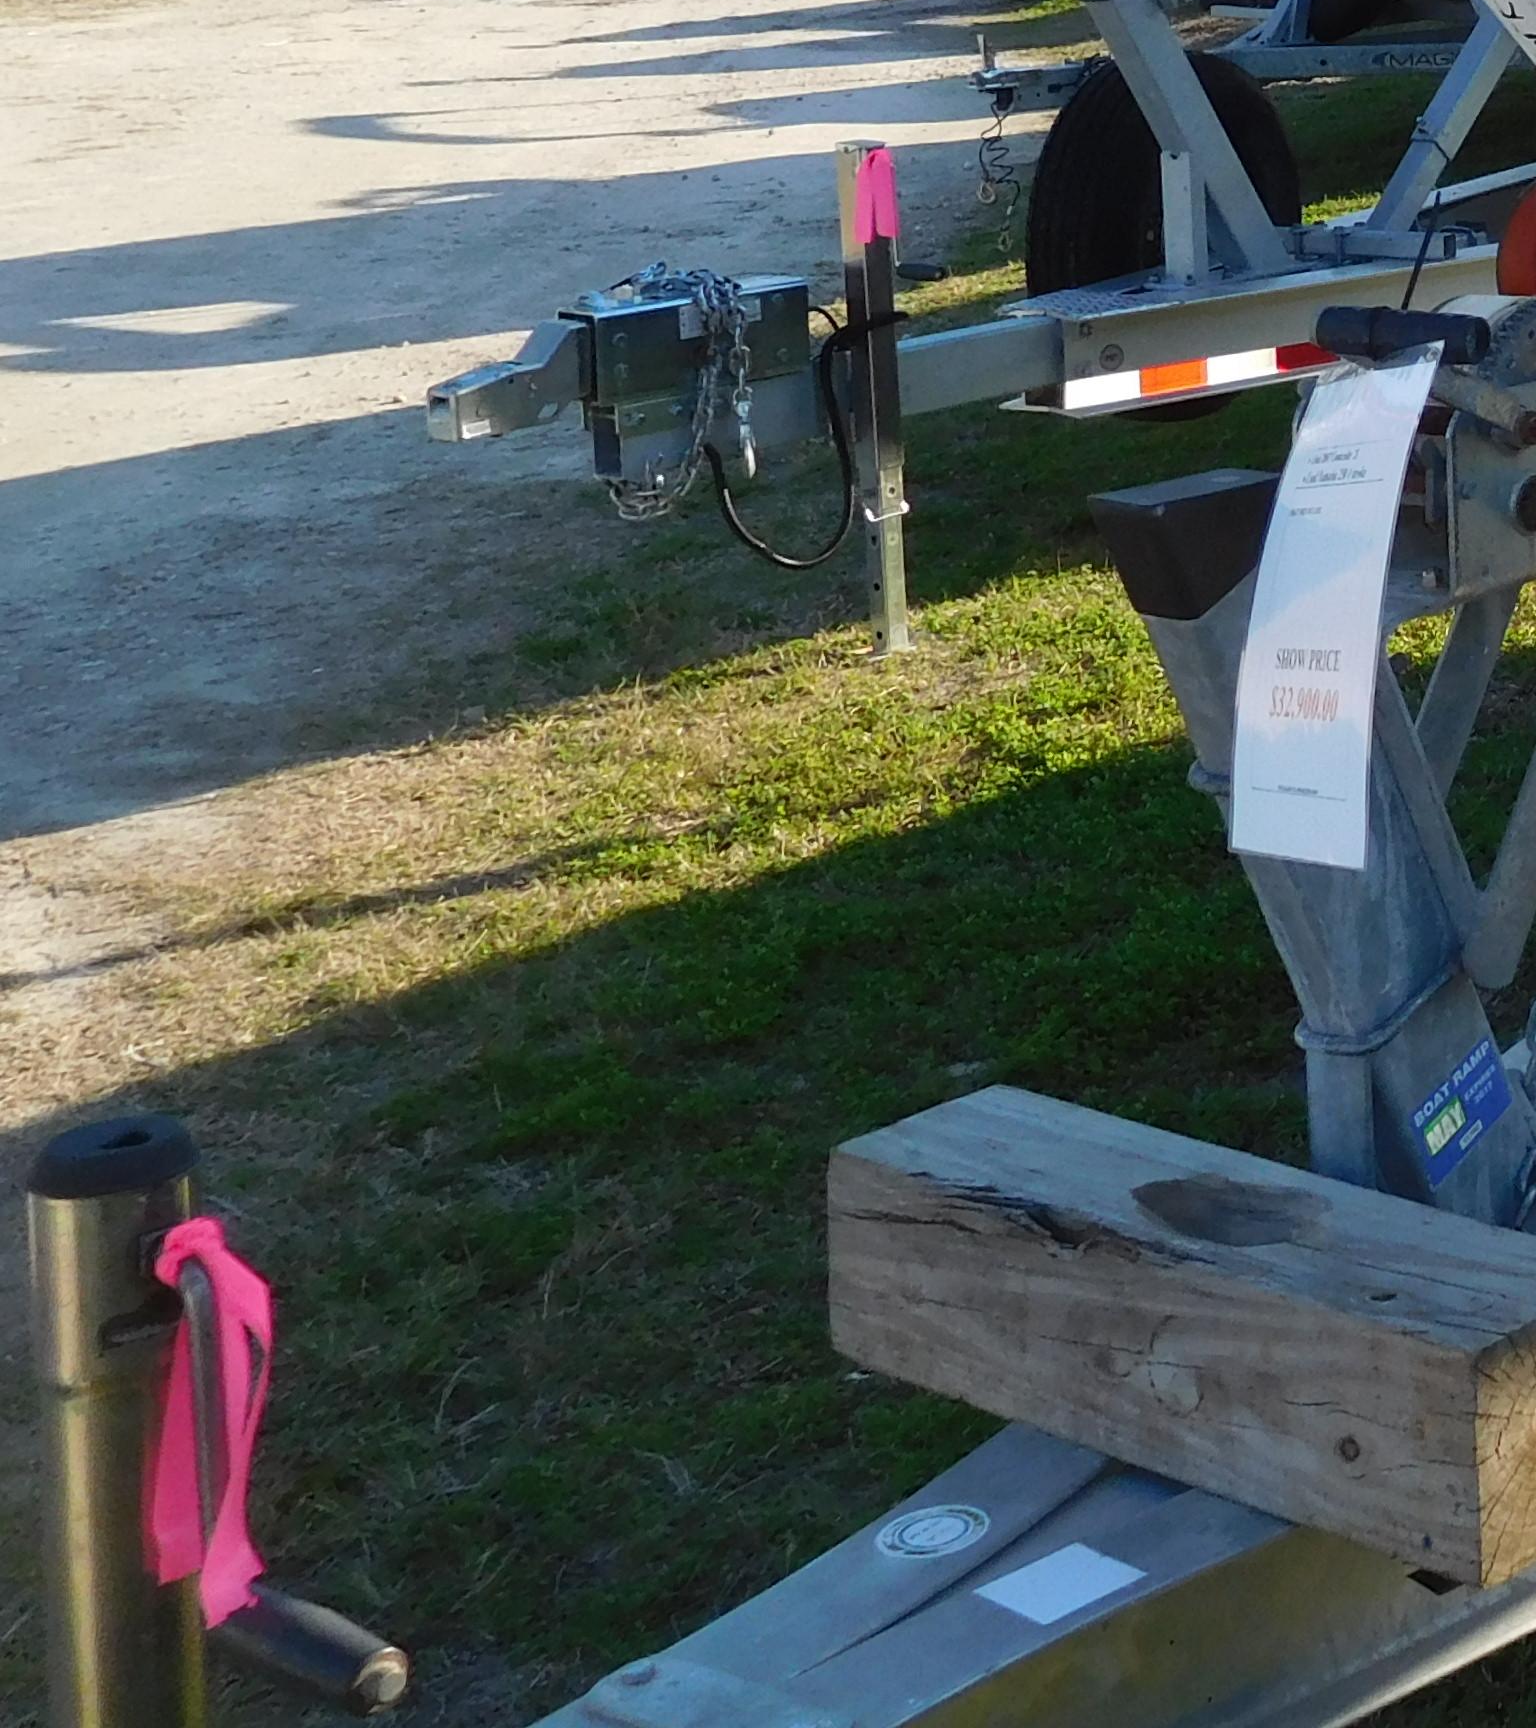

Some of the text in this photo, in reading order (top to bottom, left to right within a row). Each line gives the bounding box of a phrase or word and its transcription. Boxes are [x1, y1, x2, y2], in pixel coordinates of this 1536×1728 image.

[1275, 647, 1342, 672] SHOW PRICE
[1413, 1082, 1451, 1128] BOAT
[1452, 1040, 1491, 1087] RAMP
[1425, 1102, 1467, 1155] MAY
